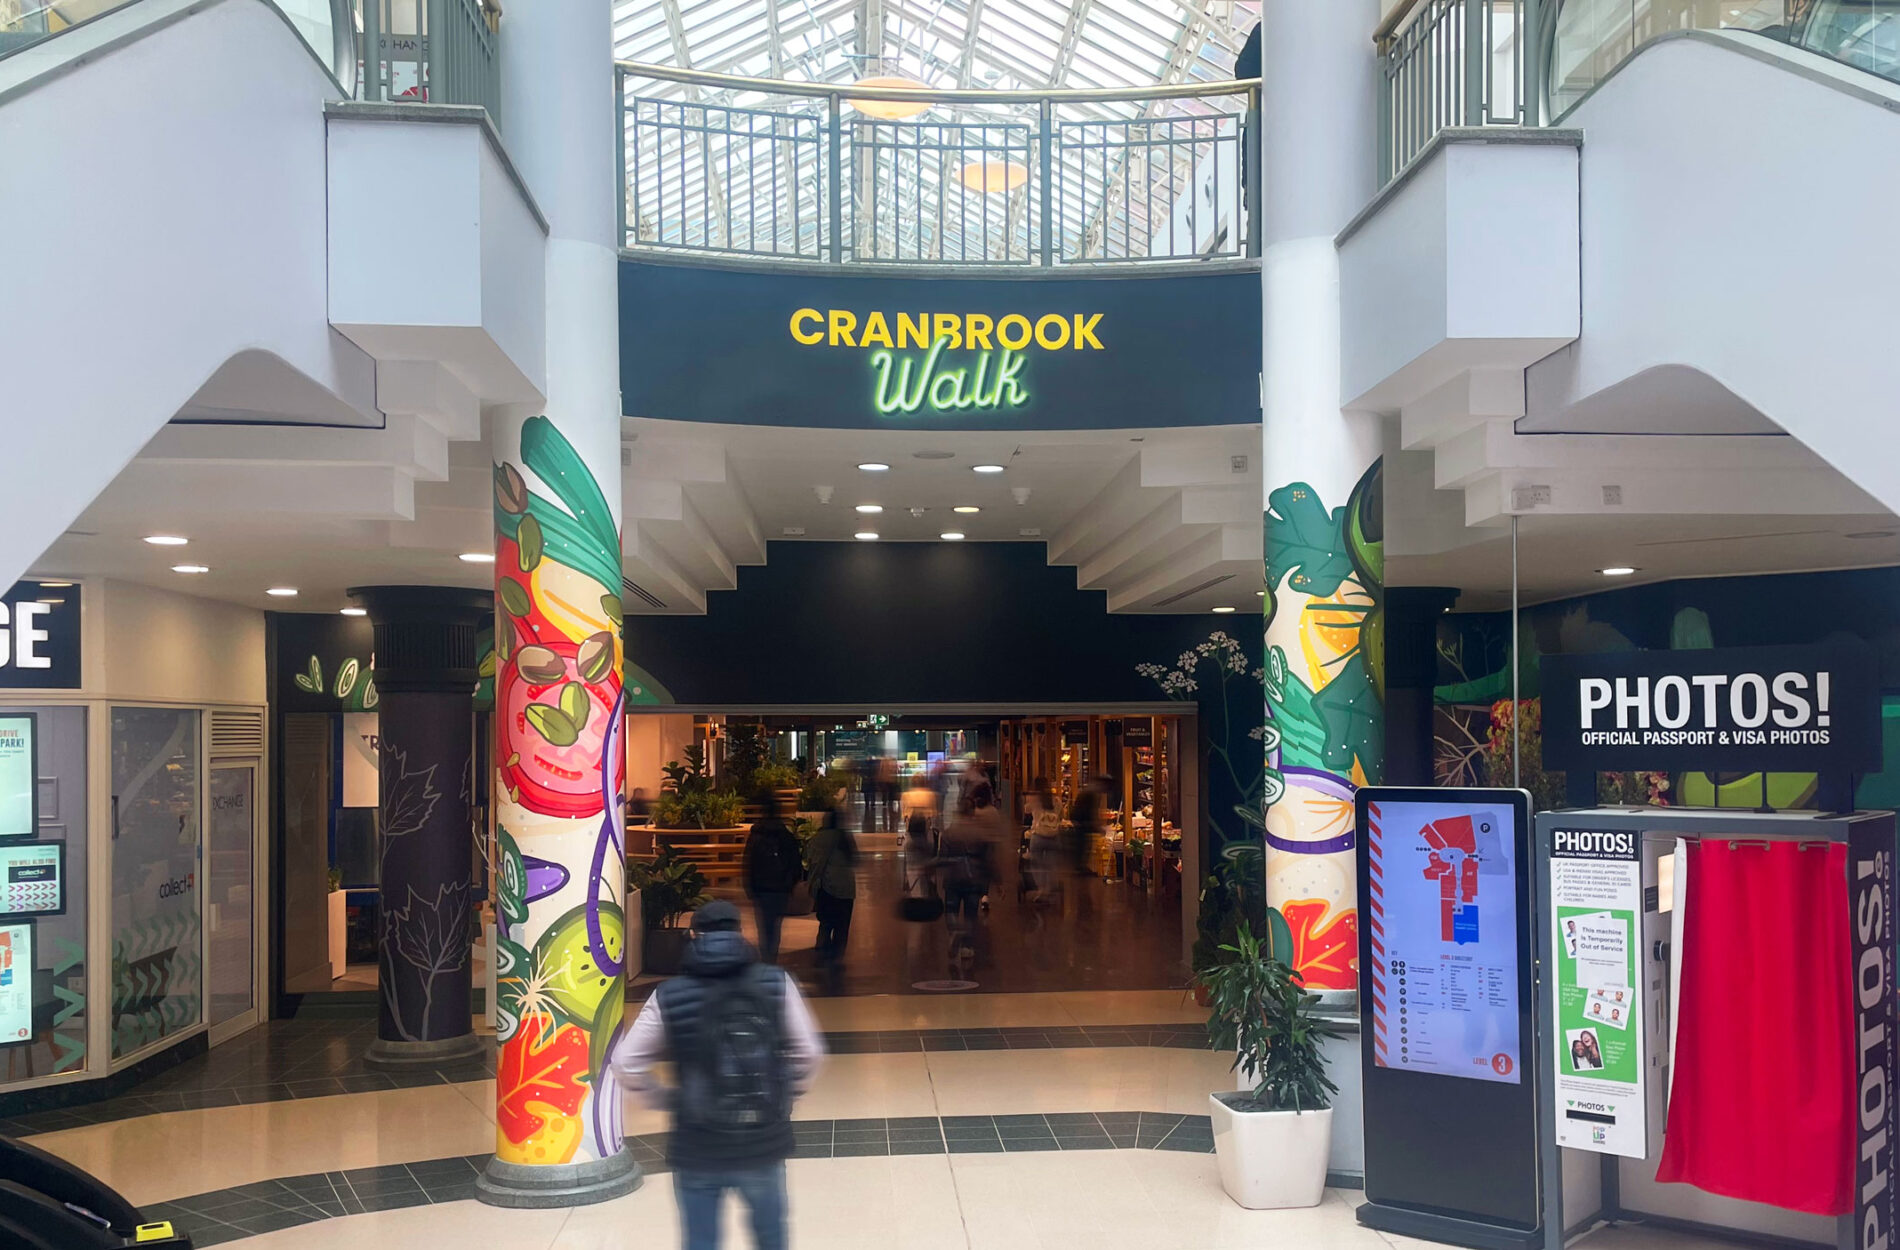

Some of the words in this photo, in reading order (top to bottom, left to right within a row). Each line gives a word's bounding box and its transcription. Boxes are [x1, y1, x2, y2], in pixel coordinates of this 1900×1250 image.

[789, 308, 1105, 350] CRANBROOK
[873, 334, 1029, 414] Walk
[0, 601, 51, 669] E
[1580, 671, 1830, 729] PHOTOS!
[0, 738, 24, 748] PARK!
[1581, 731, 1640, 746] OFFICIAL
[1643, 731, 1715, 745] PASSPORT
[1718, 731, 1730, 745] &
[1732, 730, 1766, 745] VISA
[1771, 730, 1830, 745] PHOTOS
[1554, 831, 1634, 854] PHOTOS!
[1588, 935, 1623, 945] Temporarily
[1857, 851, 1889, 1250] PHOTOS!
[1473, 1057, 1488, 1066] LEVEL
[1498, 1056, 1507, 1073] 3
[1577, 1101, 1605, 1112] PHOTOS
